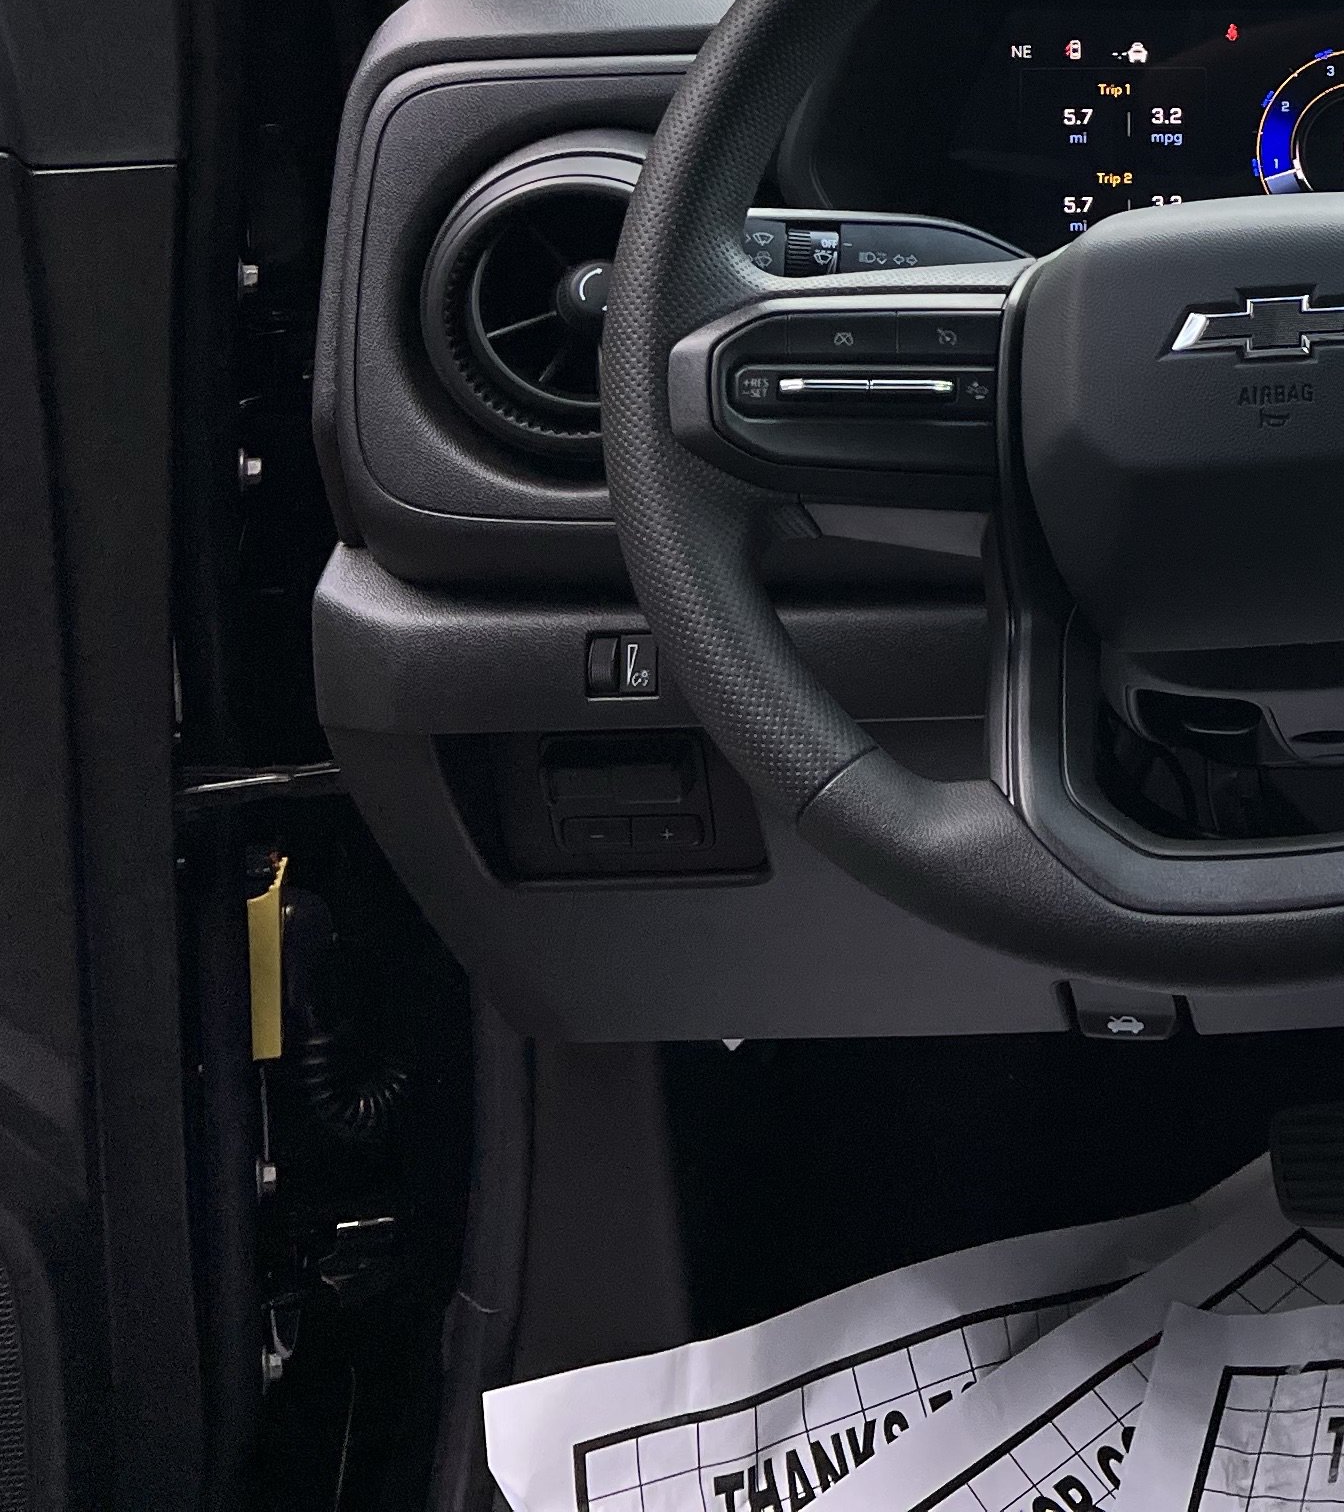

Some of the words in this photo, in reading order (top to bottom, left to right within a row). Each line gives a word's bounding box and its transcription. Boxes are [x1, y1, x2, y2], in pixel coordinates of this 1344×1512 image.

[1011, 45, 1032, 59] NE
[1326, 66, 1335, 77] 3
[1097, 83, 1122, 98] Trip
[1125, 84, 1131, 95] 1
[1281, 101, 1290, 112] 2
[1063, 108, 1093, 125] 5.7
[1151, 107, 1182, 124] 3.2
[1069, 132, 1087, 144] mi
[1151, 133, 1183, 146] mpg
[1096, 172, 1121, 187] Trip
[1123, 172, 1133, 184] 2
[1063, 196, 1093, 214] 5.7
[1069, 220, 1088, 232] mi
[1239, 383, 1314, 406] AIRBAG
